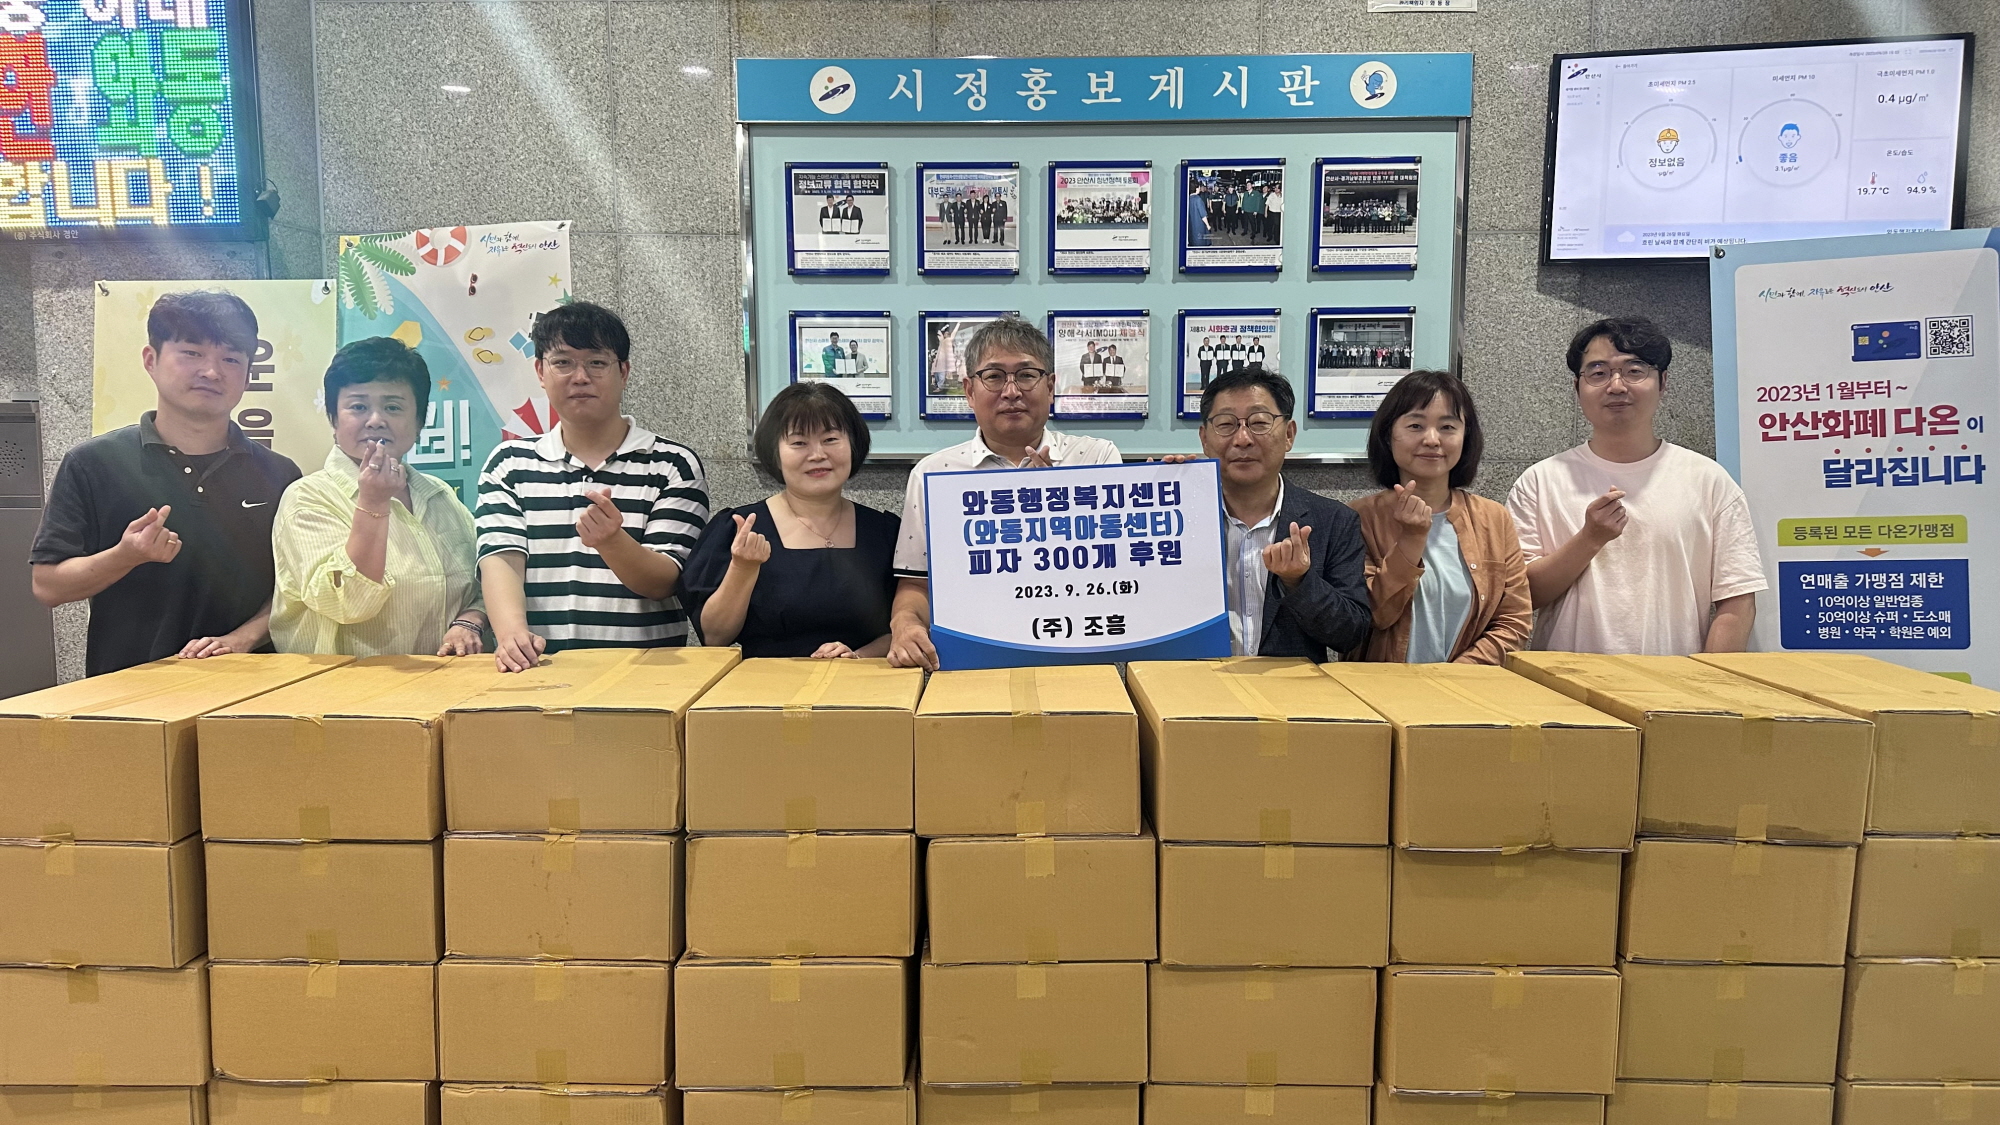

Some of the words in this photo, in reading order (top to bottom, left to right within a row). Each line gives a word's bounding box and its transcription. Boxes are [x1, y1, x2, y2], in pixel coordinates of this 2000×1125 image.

[1772, 74, 1796, 82] 미세먼지
[1877, 69, 1914, 77] 극초미세먼지
[889, 65, 1320, 112] 시정홍보게시판
[1647, 80, 1677, 88] 초미세먼지
[1877, 93, 1895, 104] 0.4
[1779, 152, 1798, 163] 좋음
[1886, 149, 1913, 157] 온도/습도
[1648, 157, 1685, 168] 정보없음
[798, 180, 832, 189] 정보교류
[834, 180, 851, 189] 협력
[853, 180, 879, 189] 협약식
[1061, 177, 1076, 185] 2023
[1077, 177, 1096, 185] 안산시
[1857, 187, 1877, 195] 19.7
[1907, 186, 1927, 194] 94.9
[1929, 186, 1937, 194] %
[29, 231, 60, 239] 주식회사
[63, 230, 79, 239] 경안
[480, 233, 502, 248] 시민과
[539, 240, 560, 250] 안산
[1759, 288, 1784, 302] 시민과
[1786, 287, 1805, 299] 함께
[1869, 282, 1894, 293] 안산
[1208, 325, 1238, 333] 시화호권
[1240, 325, 1276, 333] 정책협의회
[1756, 383, 1821, 403] 2023년
[1758, 408, 1887, 442] 안산화폐
[1894, 404, 1960, 436] 다온
[1967, 415, 1984, 433] 이
[1822, 454, 1986, 488] 달라집니다
[962, 480, 1181, 516] 와동행정복지센터
[963, 508, 1184, 546] (와동지역아동센터)
[1793, 525, 1838, 540] 등록된
[1842, 525, 1873, 539] 모든
[1878, 523, 1955, 539] 다온가맹점
[968, 548, 1022, 575] 피자
[1033, 543, 1117, 571] 300개
[1129, 539, 1183, 567] 후원
[1799, 573, 1850, 590] 연매출
[1855, 573, 1904, 589] 가맹점
[1910, 572, 1944, 589] 제한
[1014, 585, 1059, 599] 2023.
[1065, 584, 1080, 597] 9.
[1086, 580, 1140, 596] 26.(화)
[1818, 595, 1870, 608] 10억이상
[1874, 595, 1924, 608] 일반업종
[1818, 611, 1871, 624] 50억이상
[1873, 611, 1898, 624] 슈퍼
[1912, 610, 1951, 624] 도소매
[1032, 616, 1073, 640] (주)
[1084, 614, 1126, 637] 조흥
[1818, 626, 1841, 639] 병원
[1853, 626, 1877, 639] 약국
[1889, 626, 1925, 639] 학원은
[1927, 626, 1951, 639] 예외
